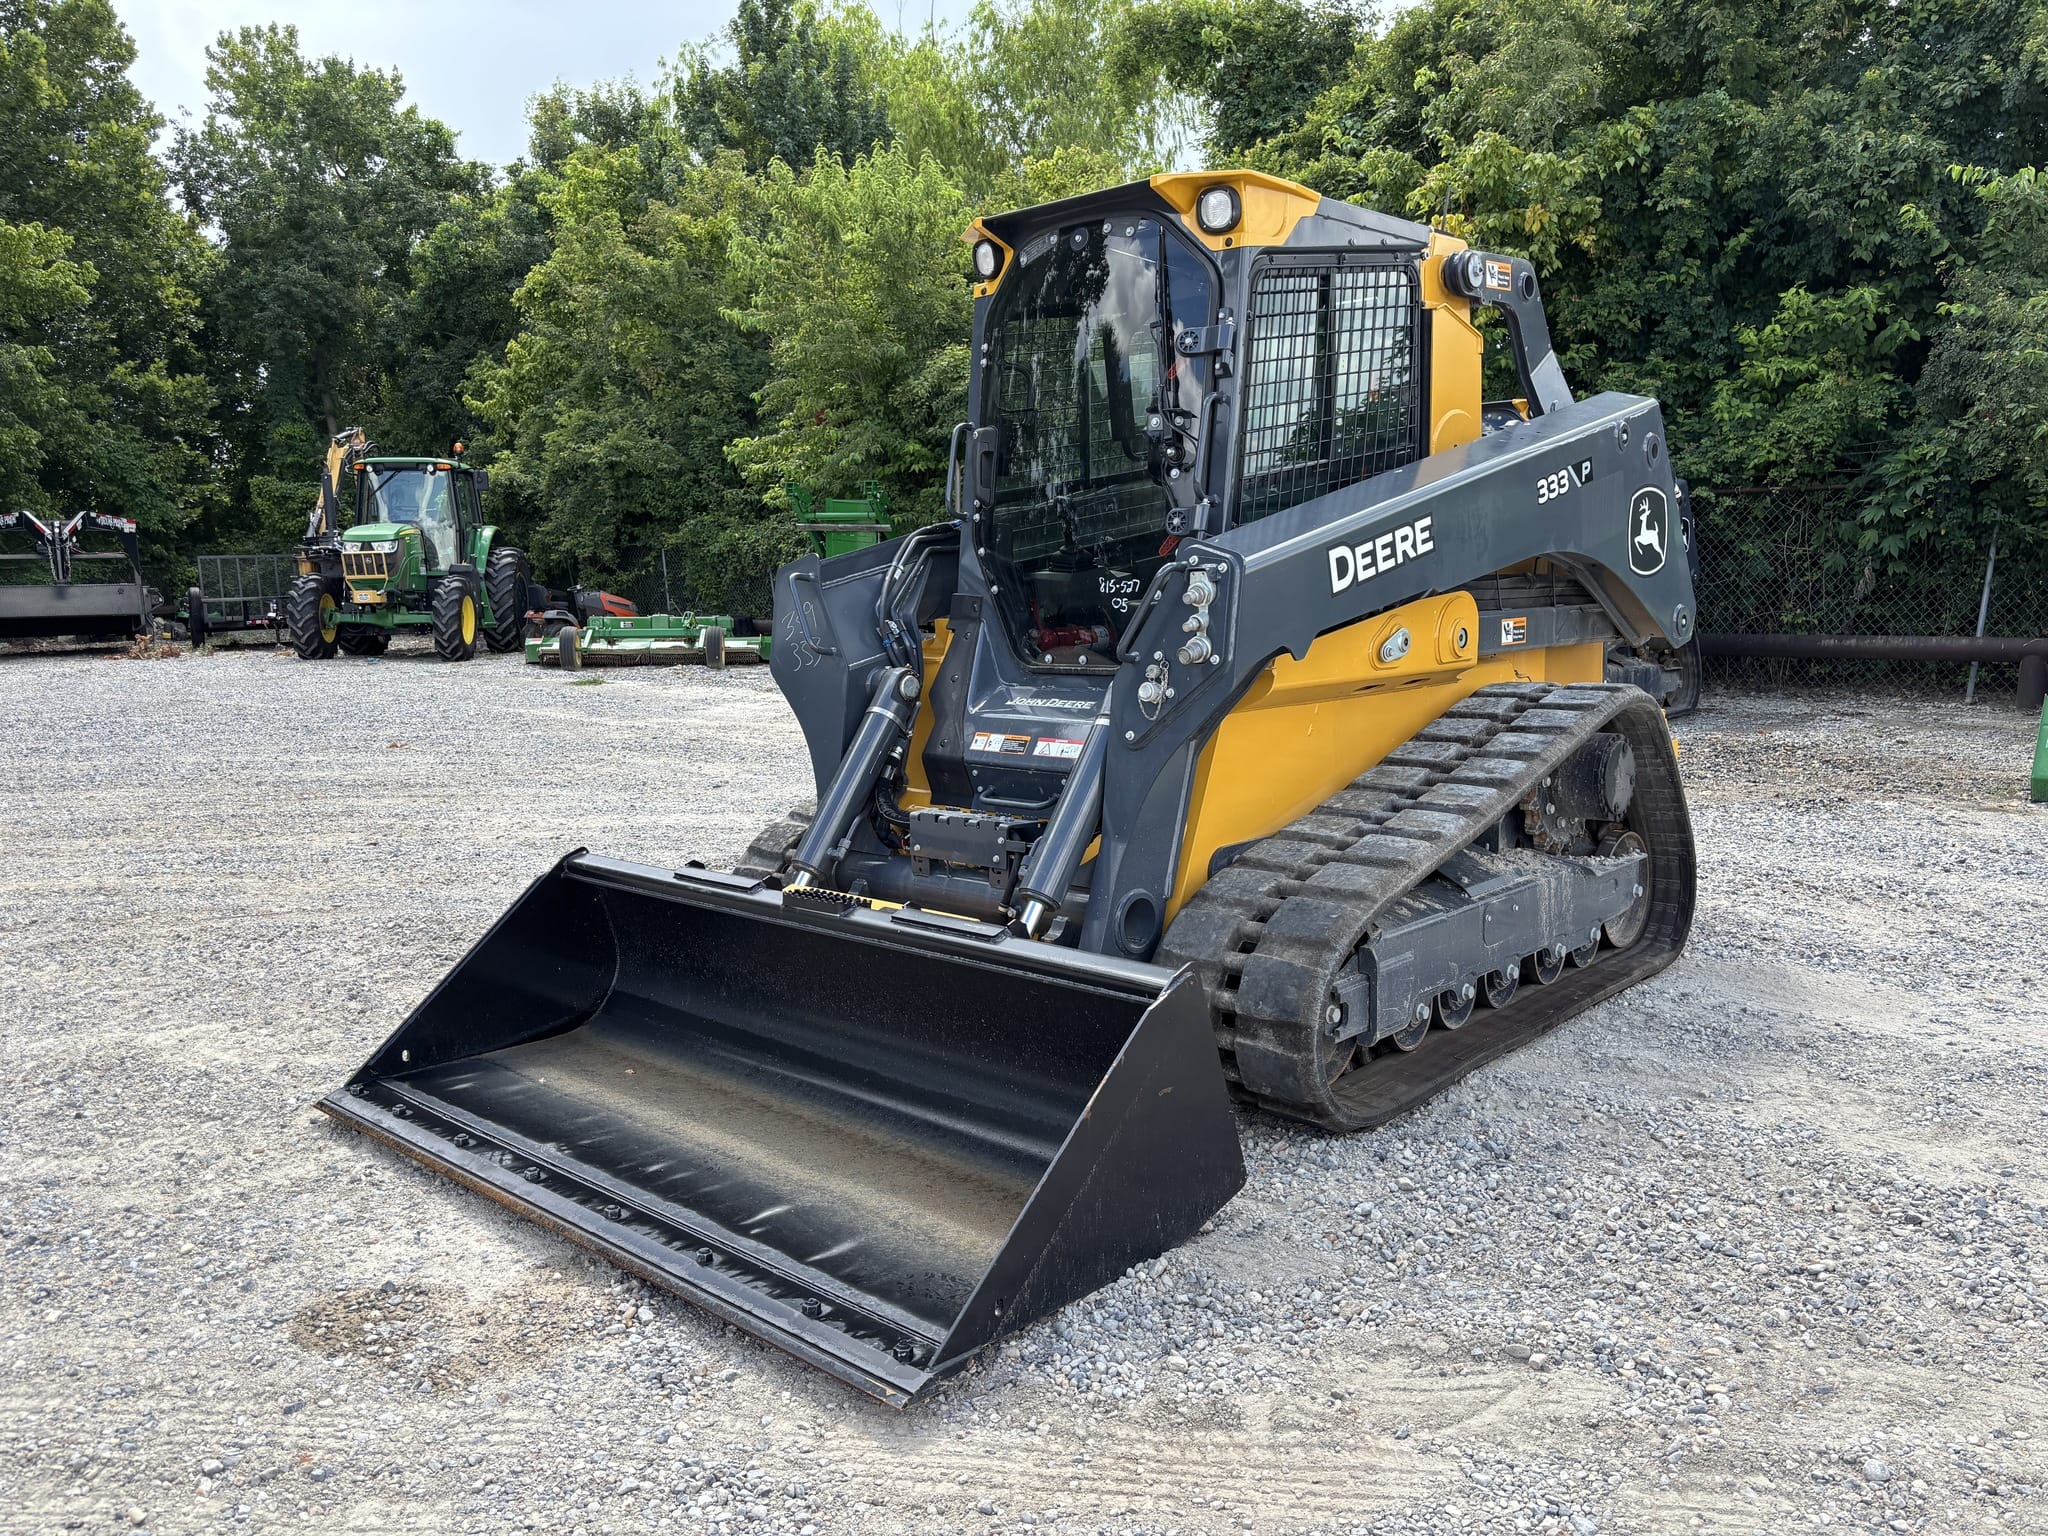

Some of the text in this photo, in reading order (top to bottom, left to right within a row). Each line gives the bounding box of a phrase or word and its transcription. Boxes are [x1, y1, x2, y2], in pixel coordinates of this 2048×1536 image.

[1328, 515, 1434, 594] DEERE
[1004, 696, 1097, 710] JOHN DEERE
